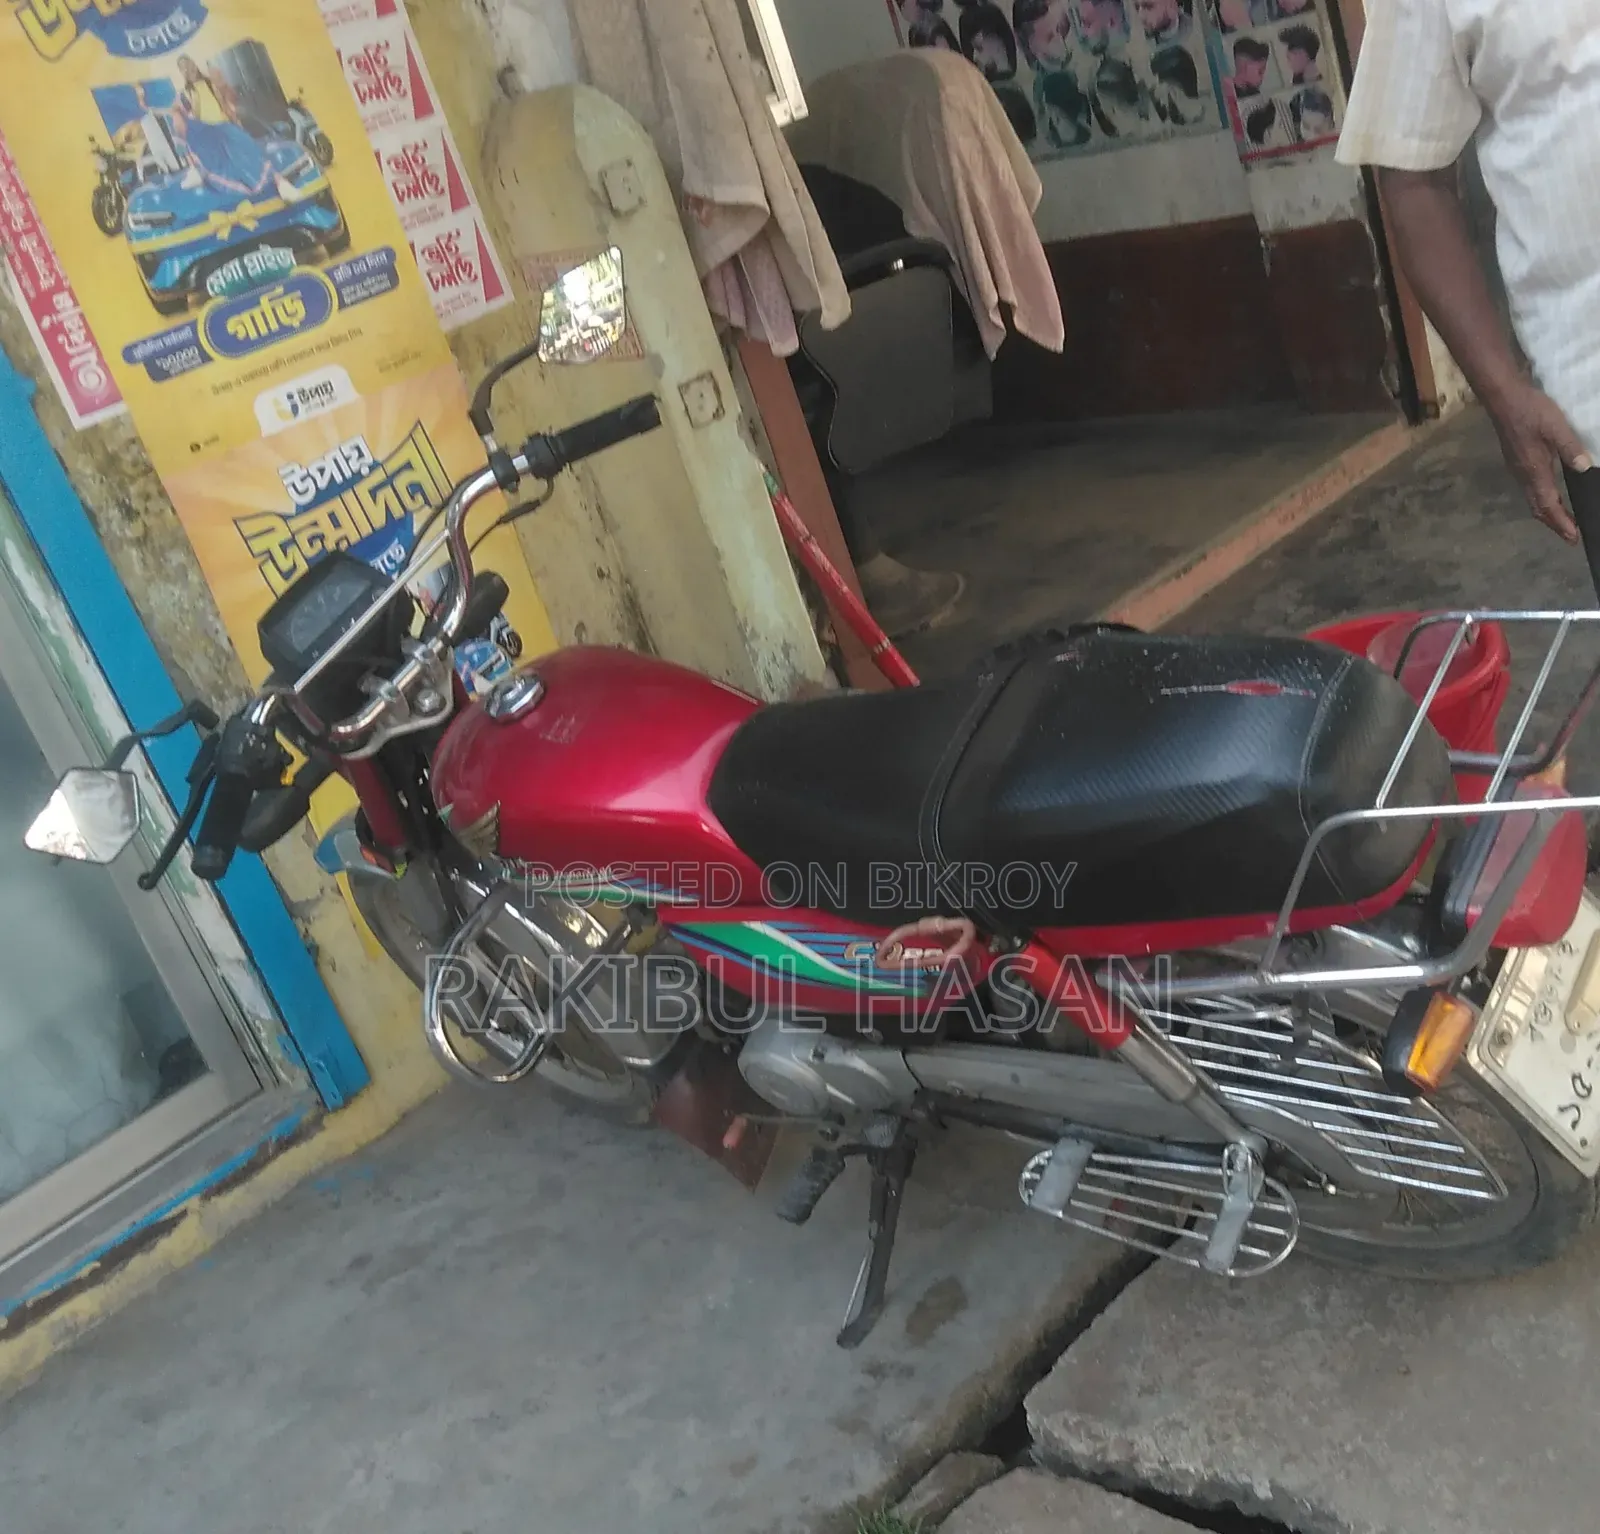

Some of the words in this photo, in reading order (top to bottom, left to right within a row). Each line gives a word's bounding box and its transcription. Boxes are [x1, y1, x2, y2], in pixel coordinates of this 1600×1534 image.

[124, 5, 197, 54] চলছে
[206, 261, 245, 298] মেগা
[244, 243, 298, 275] প্রাইজ
[227, 286, 307, 341] গাড়ি
[297, 379, 335, 406] উপায়
[277, 433, 374, 506] উপায়
[231, 417, 454, 600] উন্মাদনা
